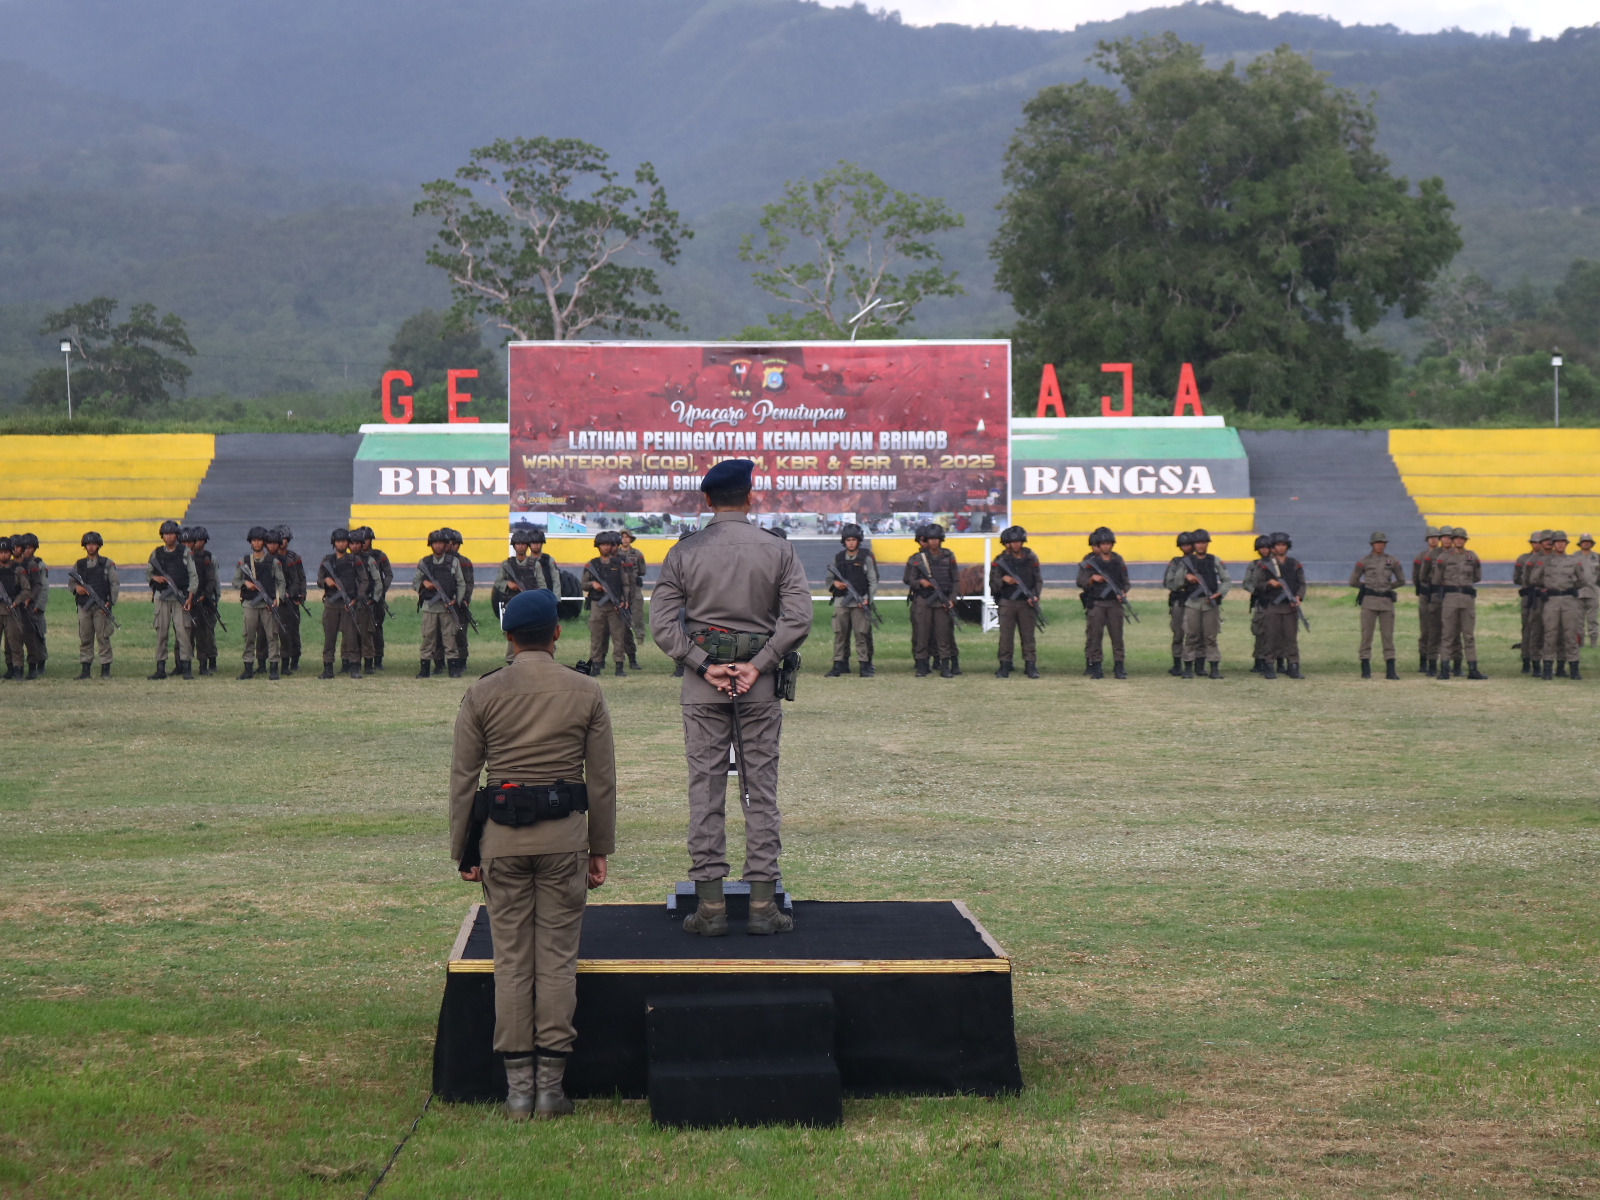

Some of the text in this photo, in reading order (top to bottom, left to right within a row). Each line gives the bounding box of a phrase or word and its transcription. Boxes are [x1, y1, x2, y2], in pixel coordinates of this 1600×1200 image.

[670, 399, 847, 428] Upacara Penutupan
[568, 430, 948, 450] LATIHAN PENINGKATAN KEMAMPUAN BRIMOB
[521, 455, 632, 470] WANTEROR
[776, 455, 818, 470] KBR
[827, 455, 841, 470] &
[851, 455, 891, 470] SAR
[900, 455, 932, 470] TA.
[940, 454, 996, 470] 2025
[379, 466, 1216, 495] BRIM BANGSA
[618, 475, 669, 491] SATUAN
[776, 475, 842, 491] SULAWESI
[847, 475, 897, 491] TENGAH
